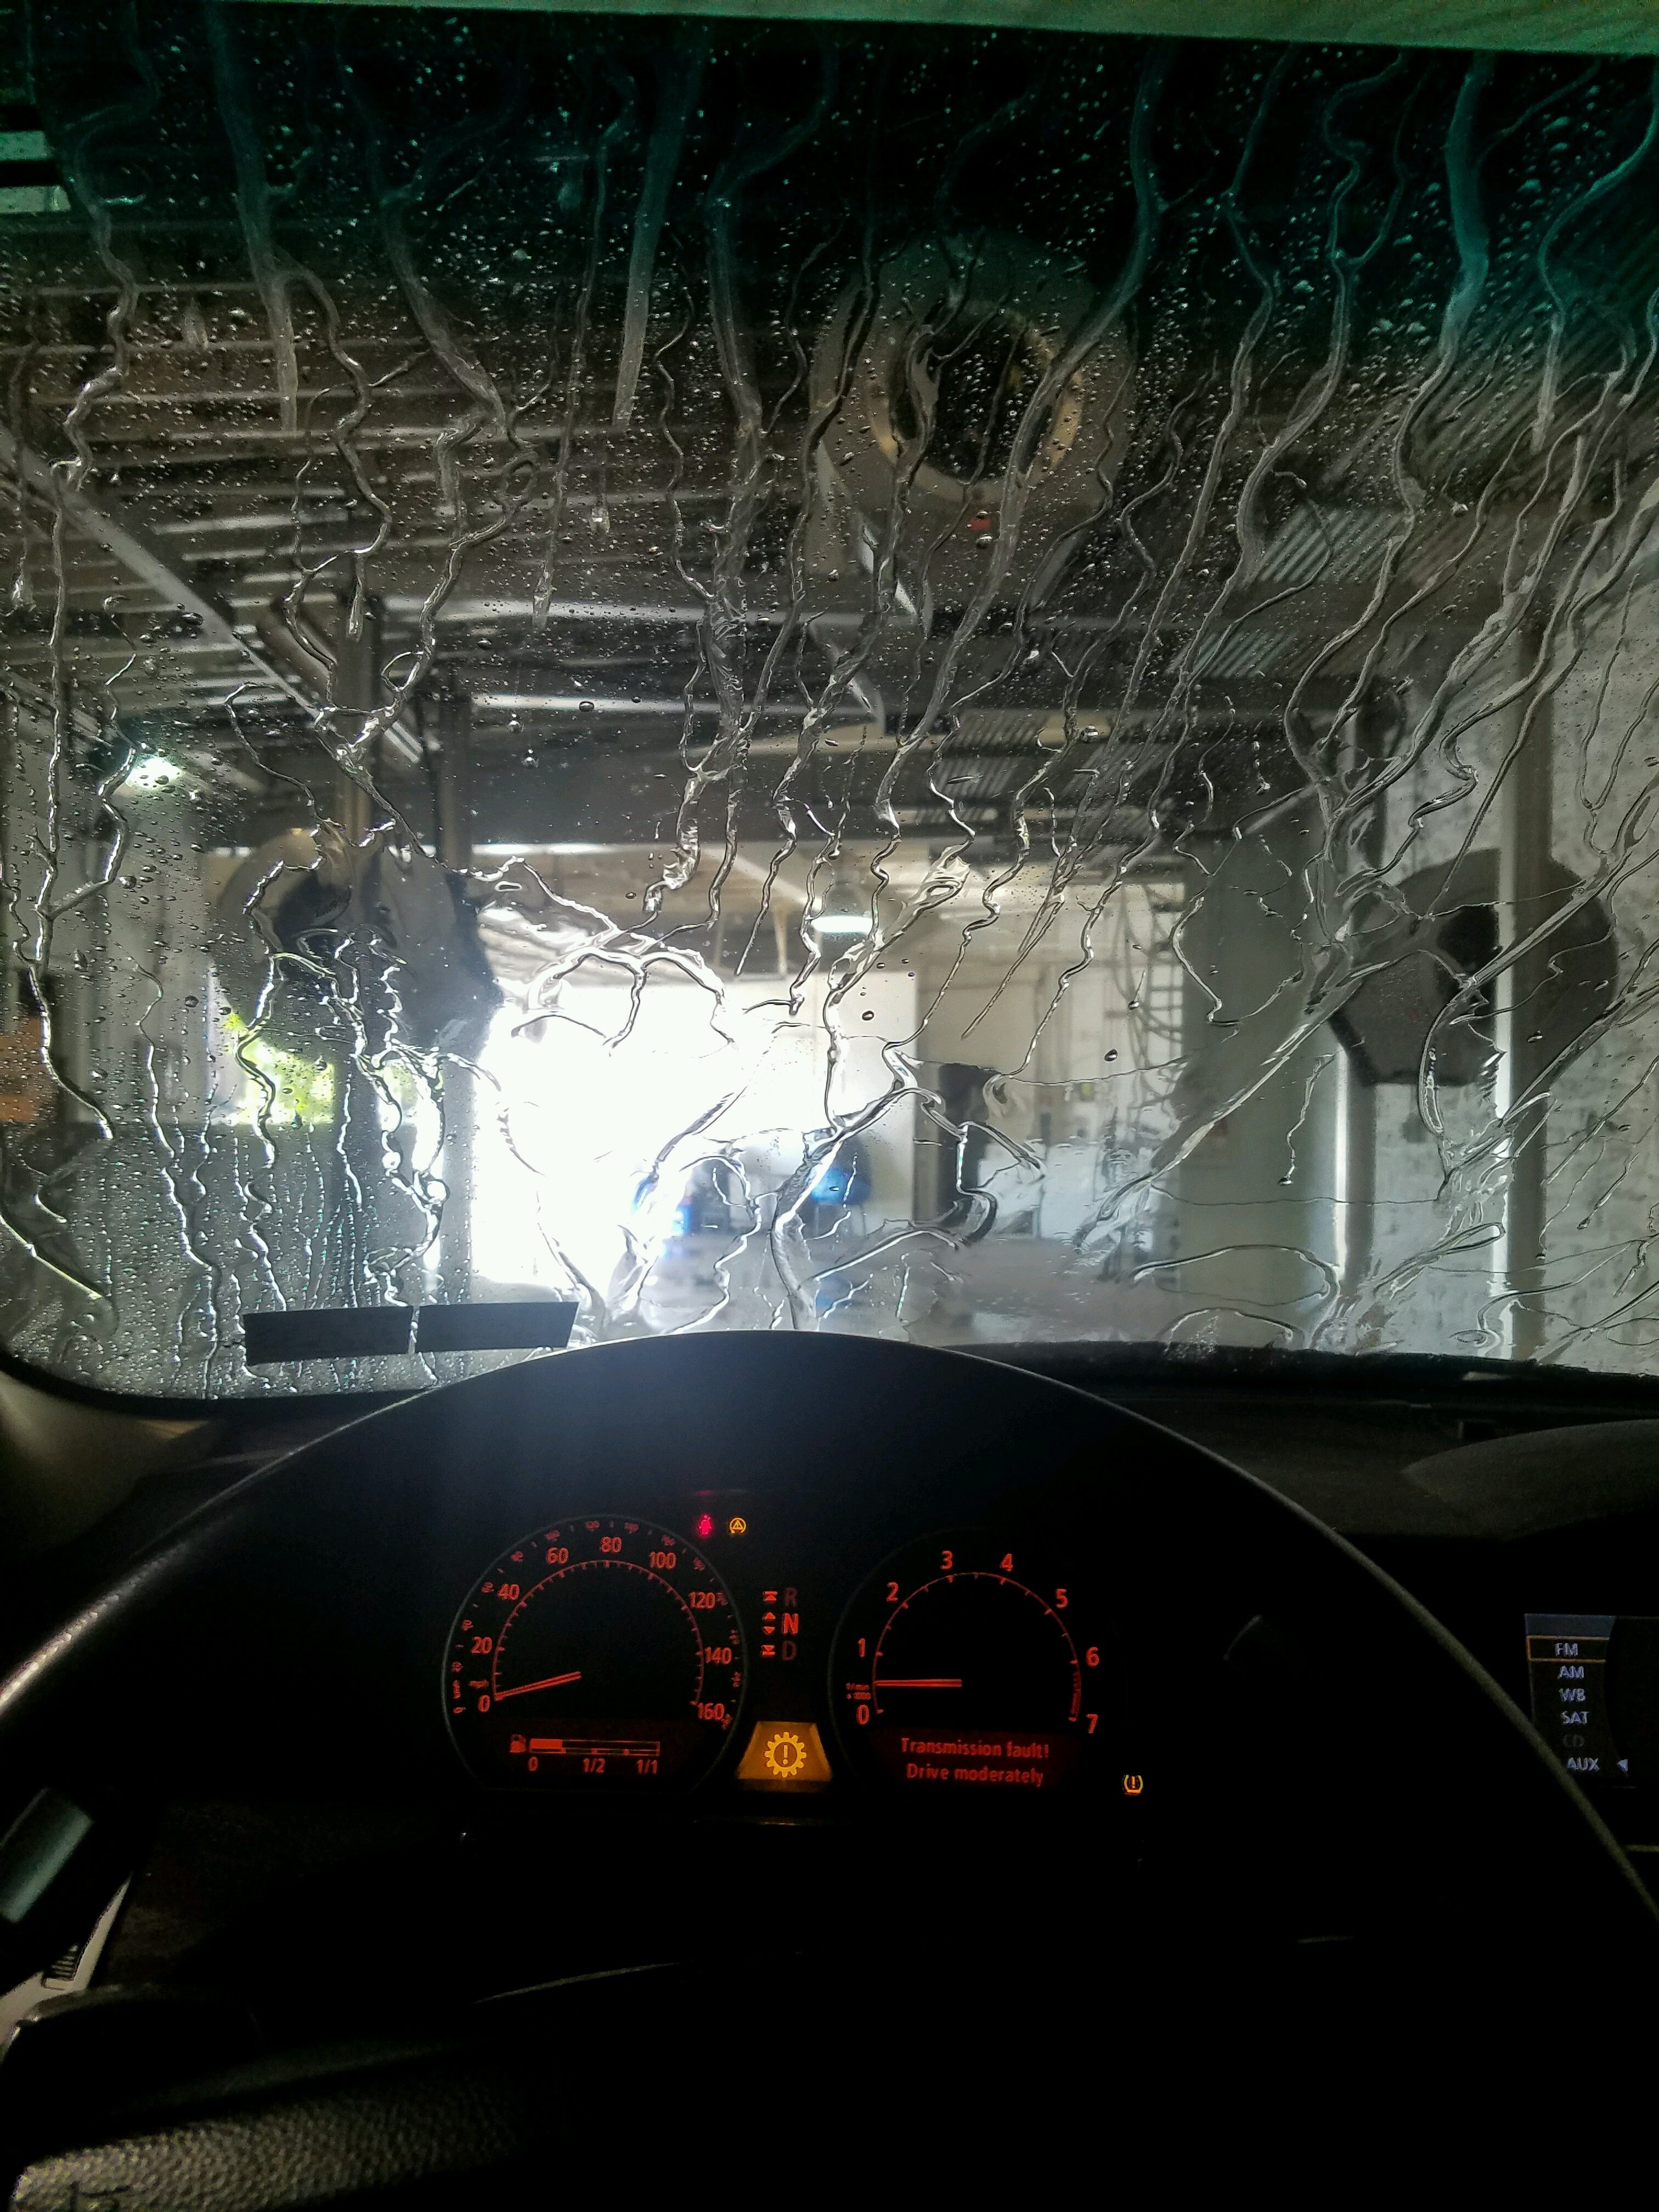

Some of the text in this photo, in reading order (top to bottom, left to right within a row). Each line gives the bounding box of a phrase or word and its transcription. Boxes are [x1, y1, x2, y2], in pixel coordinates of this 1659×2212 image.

[600, 1536, 622, 1553] 80
[546, 1547, 569, 1564] 60
[650, 1551, 676, 1569] 100
[940, 1550, 953, 1570] 3
[999, 1553, 1014, 1572] 4
[496, 1583, 520, 1600] 40
[689, 1591, 715, 1610] 120
[783, 1586, 798, 1607] R
[887, 1582, 899, 1602] 2
[1055, 1589, 1068, 1609] 5
[782, 1612, 799, 1635] N
[471, 1636, 493, 1655] 20
[705, 1646, 732, 1664] 140
[781, 1640, 797, 1662] D
[857, 1638, 866, 1658] 1
[1555, 1643, 1578, 1656] FM
[1085, 1646, 1099, 1668] 6
[1558, 1666, 1584, 1679] AM
[477, 1695, 490, 1713] 0
[1559, 1688, 1586, 1702] WB
[696, 1702, 725, 1720] 160
[856, 1704, 870, 1725] 0
[1561, 1711, 1589, 1725] SAT
[1085, 1713, 1098, 1734] 7
[901, 1737, 1002, 1756] Transmission
[528, 1756, 658, 1774] 0 1/2 1/1
[1567, 1758, 1600, 1771] AUX
[906, 1763, 1043, 1788] Drive moderately
